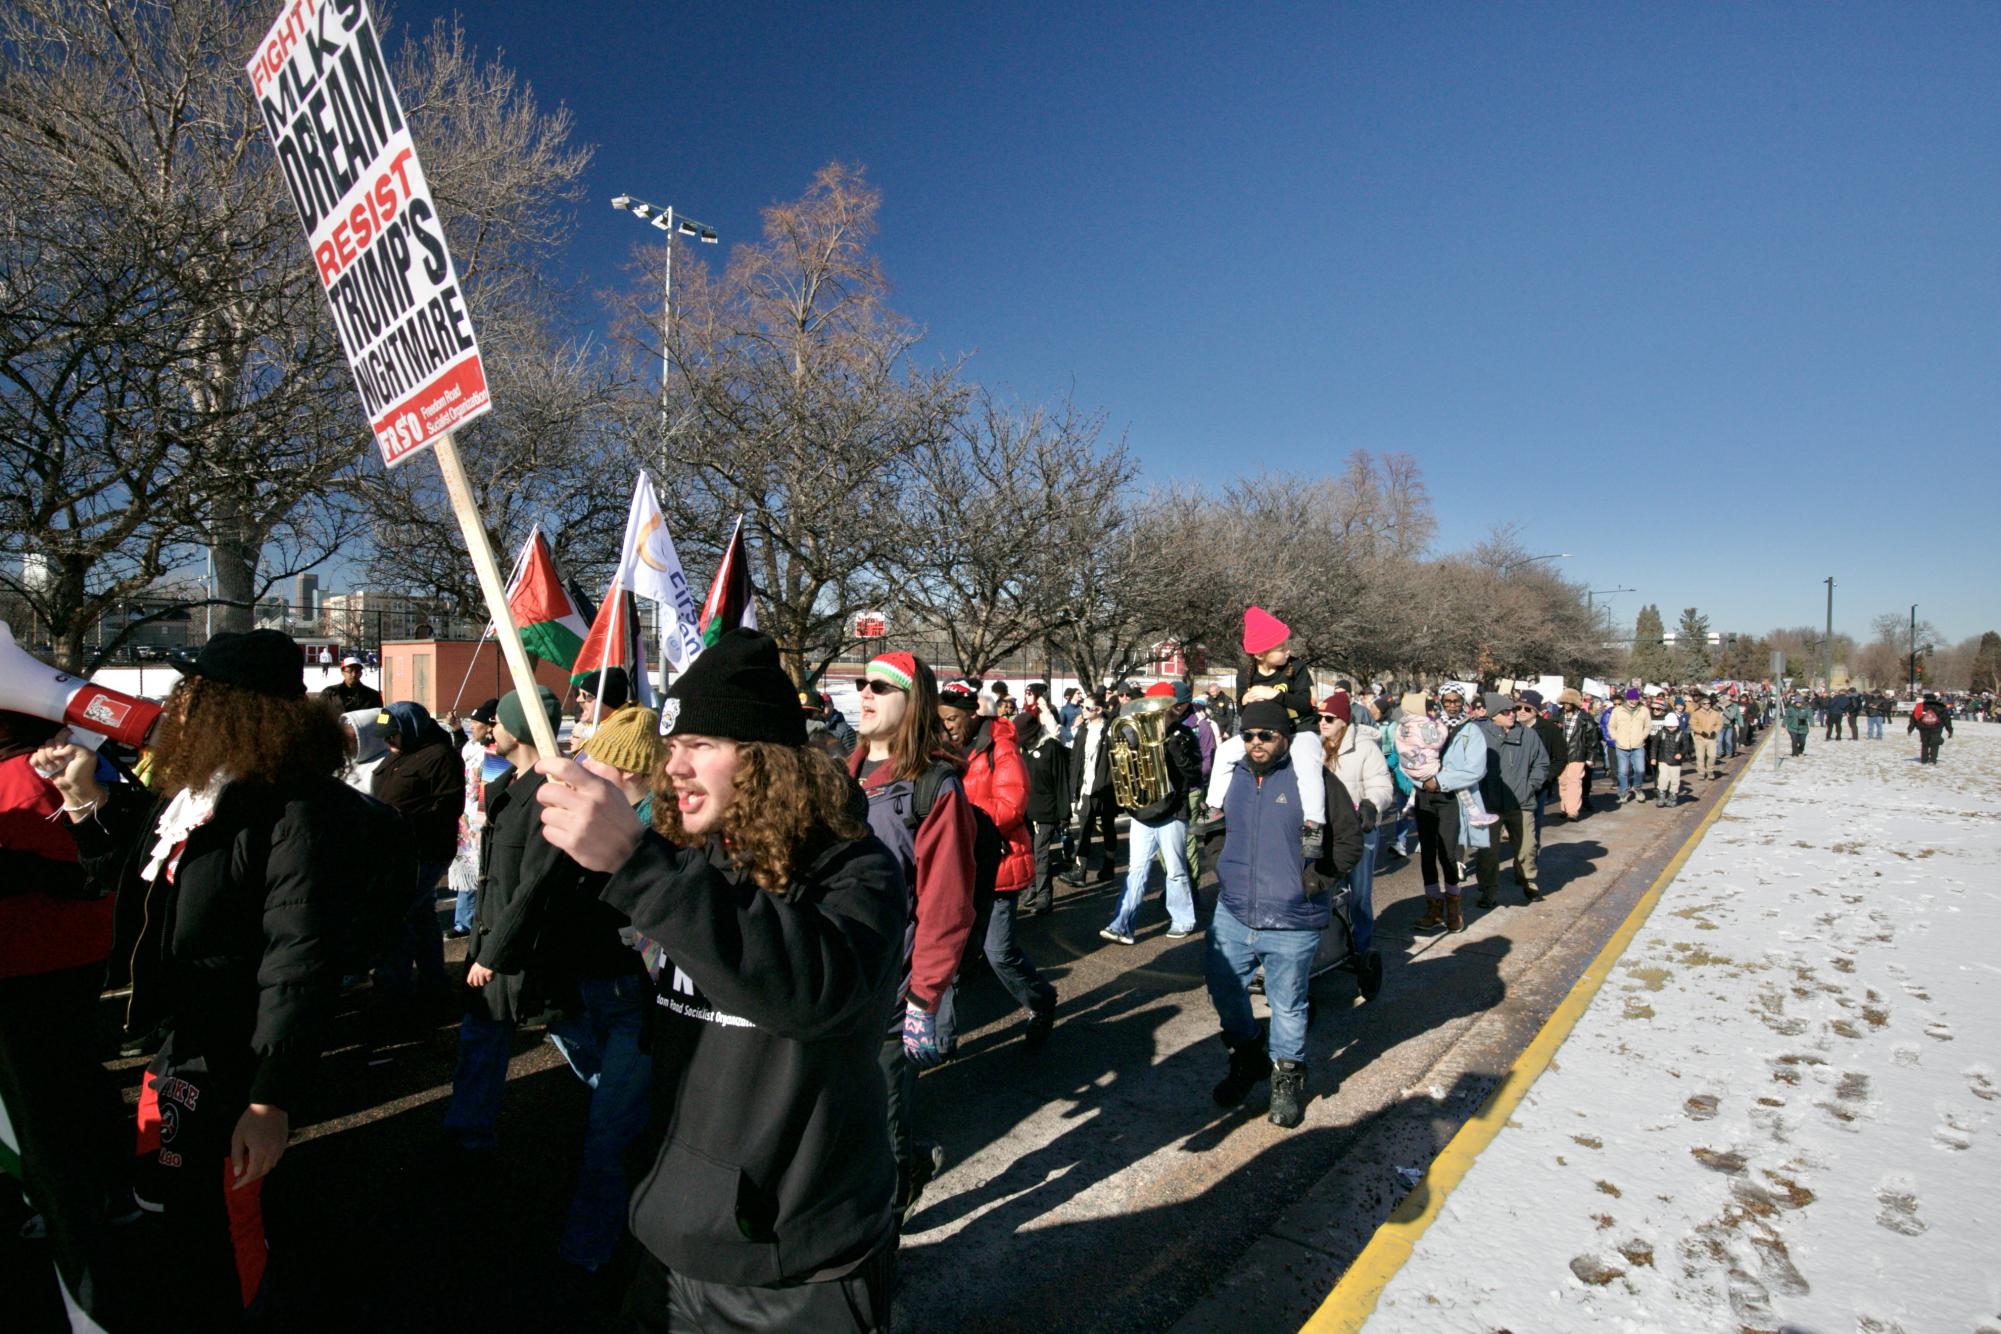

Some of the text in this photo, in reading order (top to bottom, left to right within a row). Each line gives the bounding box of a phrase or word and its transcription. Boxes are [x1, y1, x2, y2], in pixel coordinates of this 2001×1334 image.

[252, 0, 305, 97] FIGHT
[278, 18, 403, 236] DREAM
[314, 147, 412, 287] RESIST
[328, 198, 448, 358] TRUMP'S
[353, 285, 474, 418] NIGHTMARE
[378, 411, 424, 460] FRSO
[420, 382, 462, 420] Freedom Road
[425, 389, 487, 435] Socialist Organization
[684, 1004, 714, 1022] Socialist
